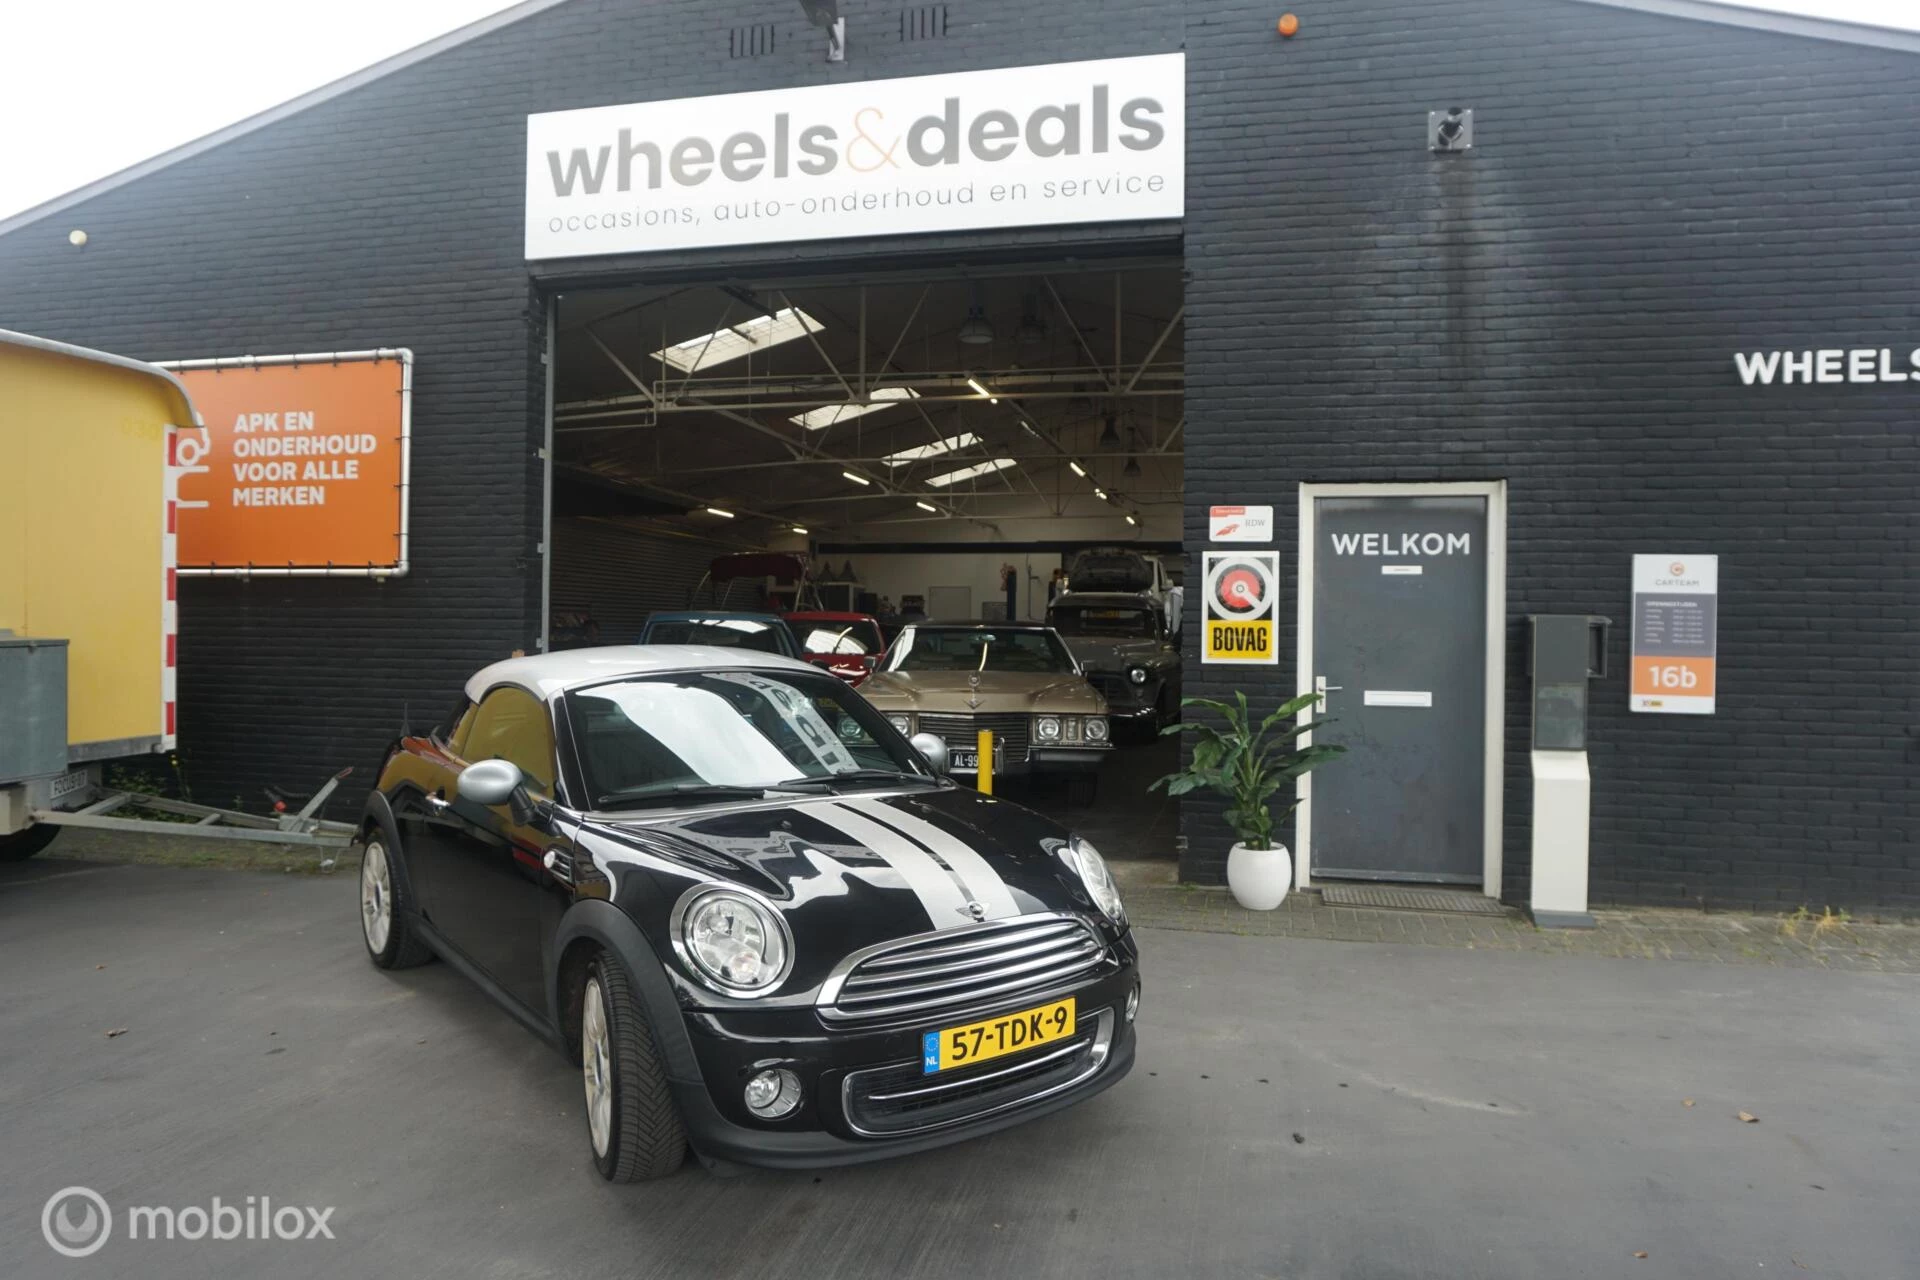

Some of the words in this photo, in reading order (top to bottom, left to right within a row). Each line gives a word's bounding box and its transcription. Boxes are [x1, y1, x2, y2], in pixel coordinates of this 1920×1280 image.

[548, 205, 701, 233] occasions,
[714, 181, 974, 221] auto-onderhoud
[989, 182, 1027, 202] en
[1043, 171, 1165, 199] service
[233, 412, 279, 433] APK
[284, 410, 314, 431] EN
[233, 434, 377, 458] ONDERHOUD
[233, 462, 297, 482] VOOR
[302, 459, 359, 481] ALLE
[232, 486, 325, 507] MERKEN
[1245, 518, 1266, 528] RDW
[1331, 532, 1471, 556] WELKOM
[1213, 626, 1267, 652] BOVAG
[1648, 664, 1698, 689] 16b
[952, 1006, 1068, 1061] 57-TDK-9
[925, 1057, 938, 1066] NL
